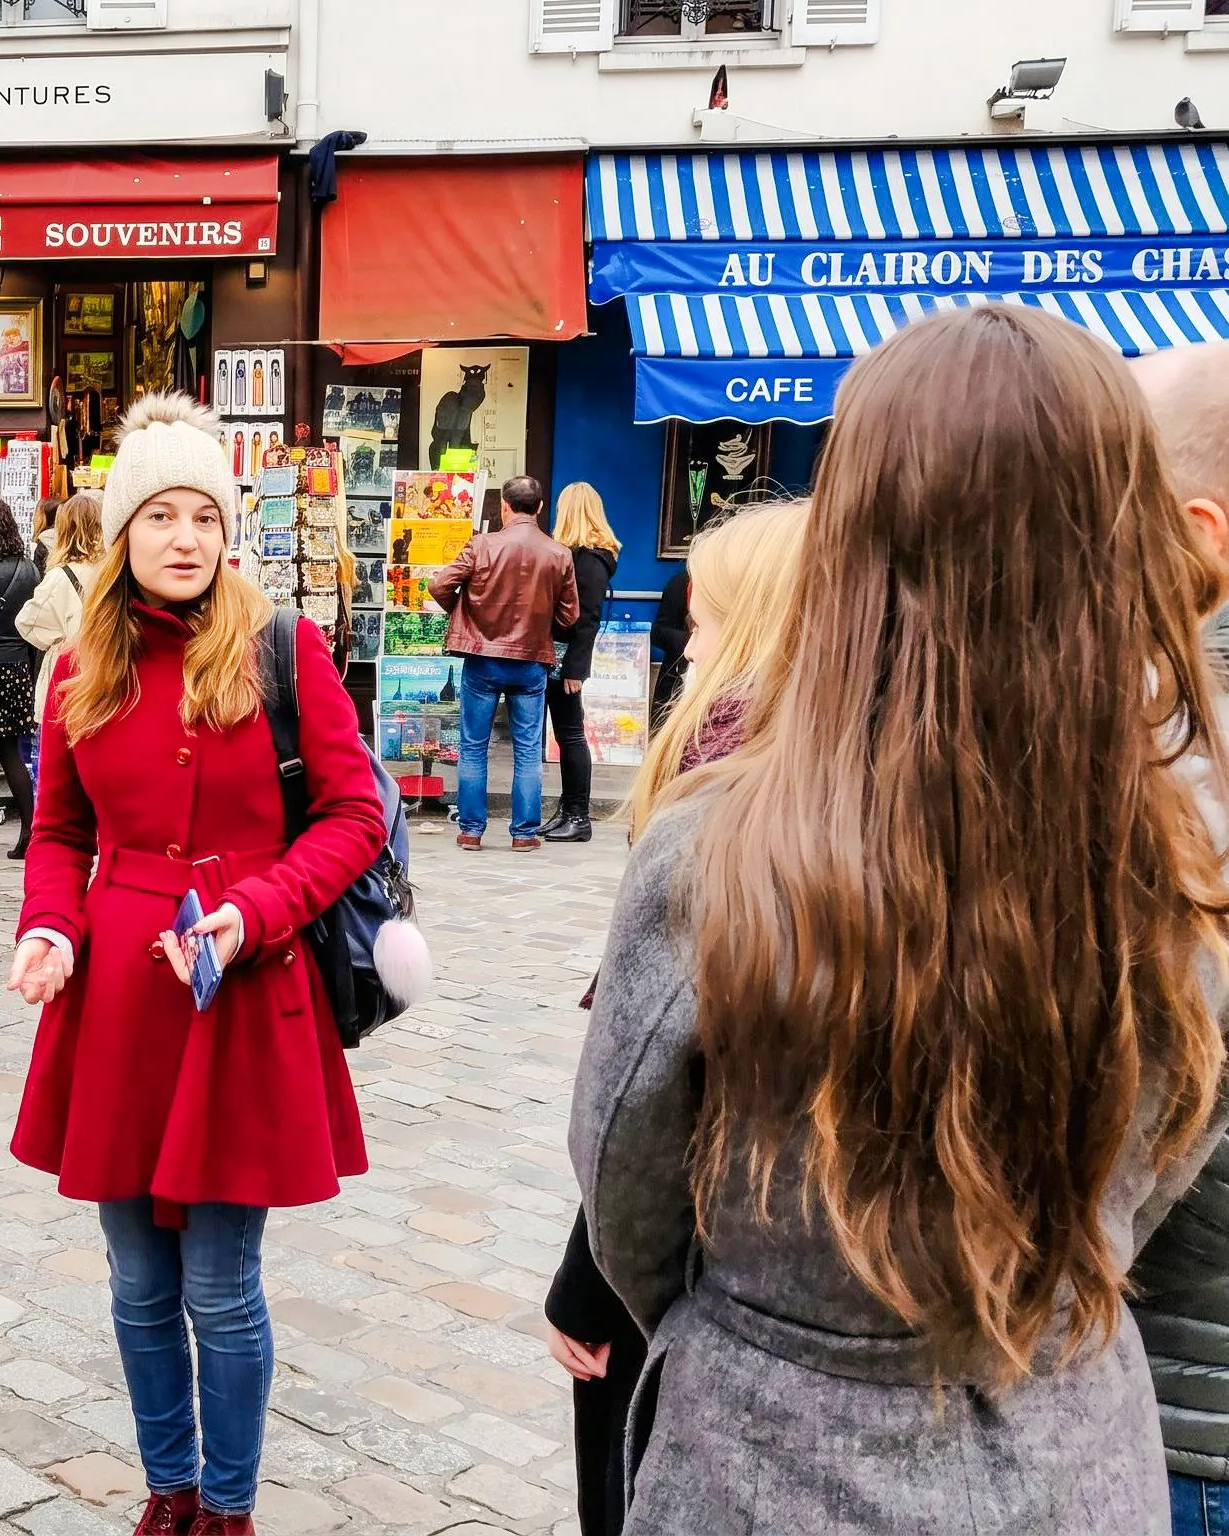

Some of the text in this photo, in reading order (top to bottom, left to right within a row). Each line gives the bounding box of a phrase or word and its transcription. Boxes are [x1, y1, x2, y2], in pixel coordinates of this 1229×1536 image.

[45, 221, 242, 247] SOUVENIRS
[718, 253, 776, 286] AU
[802, 250, 994, 287] CLAIRON
[1021, 249, 1104, 284] DES
[725, 377, 813, 402] CAFE
